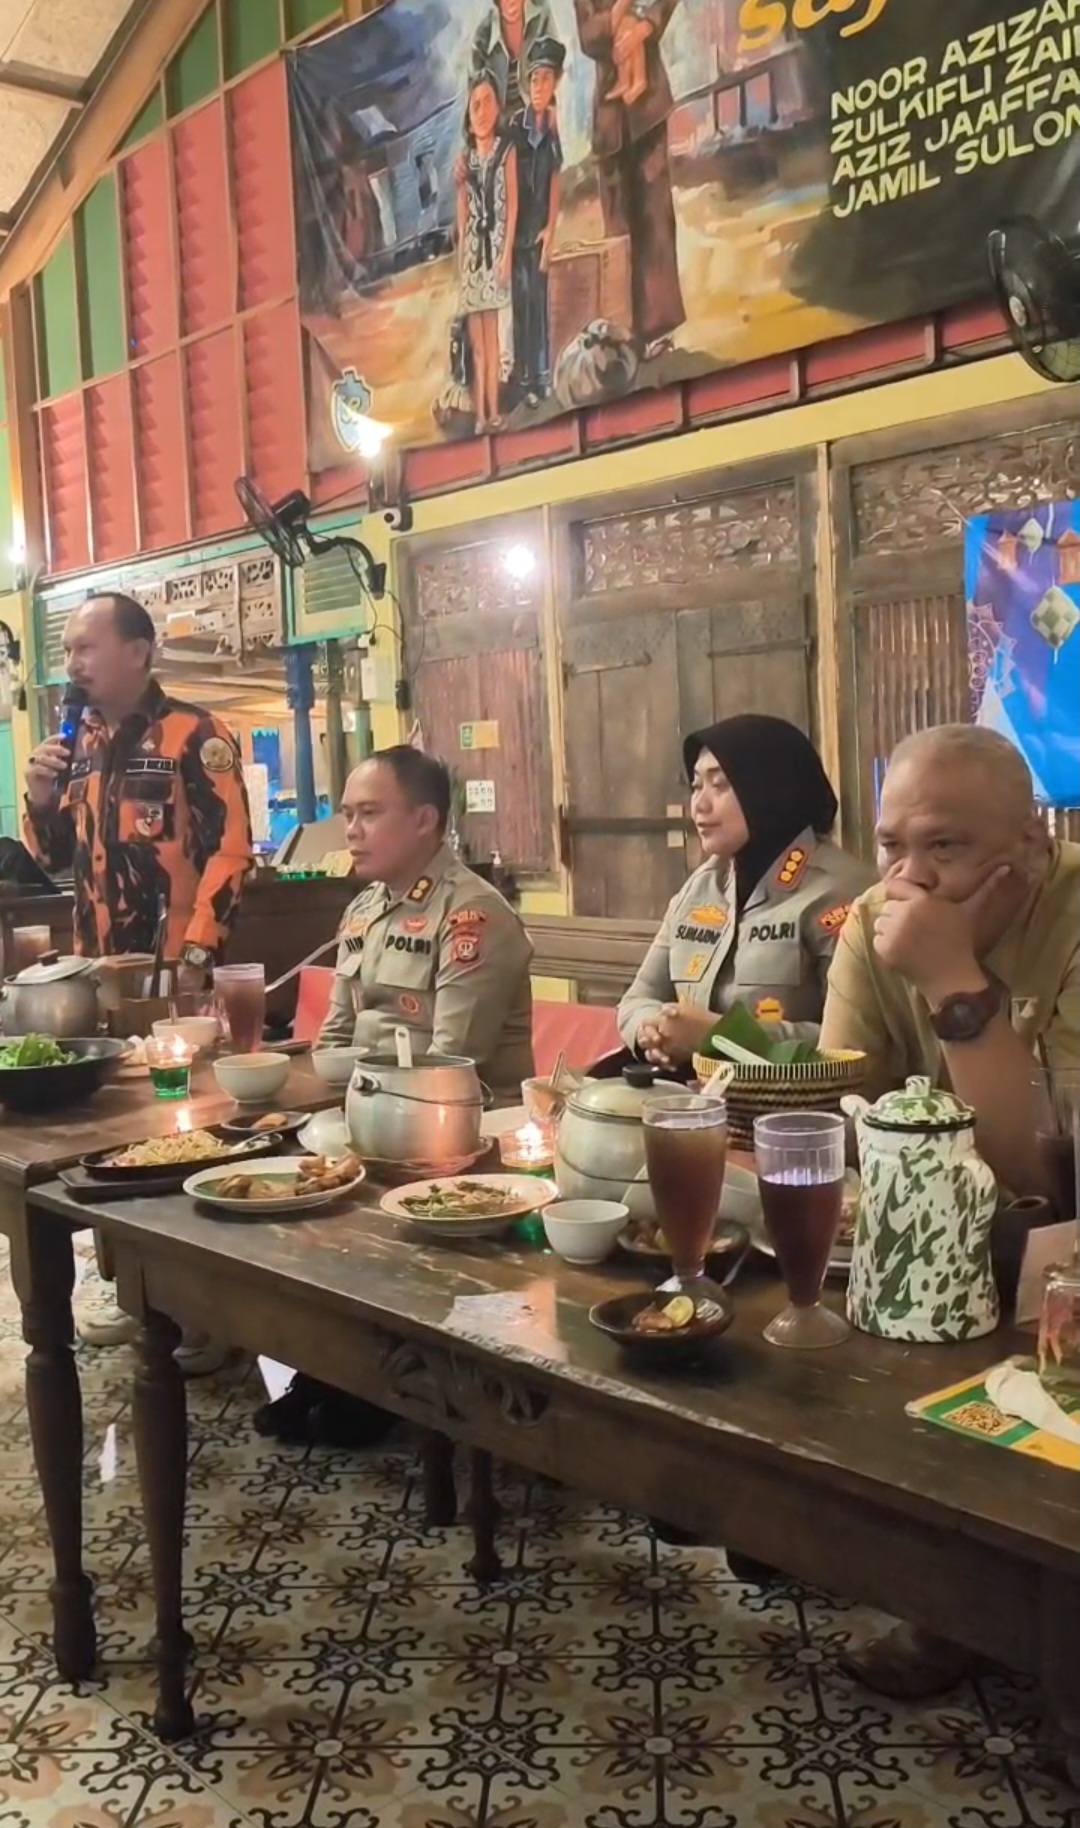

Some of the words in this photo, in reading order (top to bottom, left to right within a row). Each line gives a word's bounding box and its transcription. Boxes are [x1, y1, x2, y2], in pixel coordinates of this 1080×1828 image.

[831, 56, 928, 120] NOOR
[831, 65, 992, 154] ZULKIFLI
[1005, 24, 1080, 84] ZAI
[832, 131, 911, 186] AZIZ
[833, 160, 941, 218] JAMIL
[385, 934, 431, 955] POLRI
[749, 922, 796, 942] POLRI
